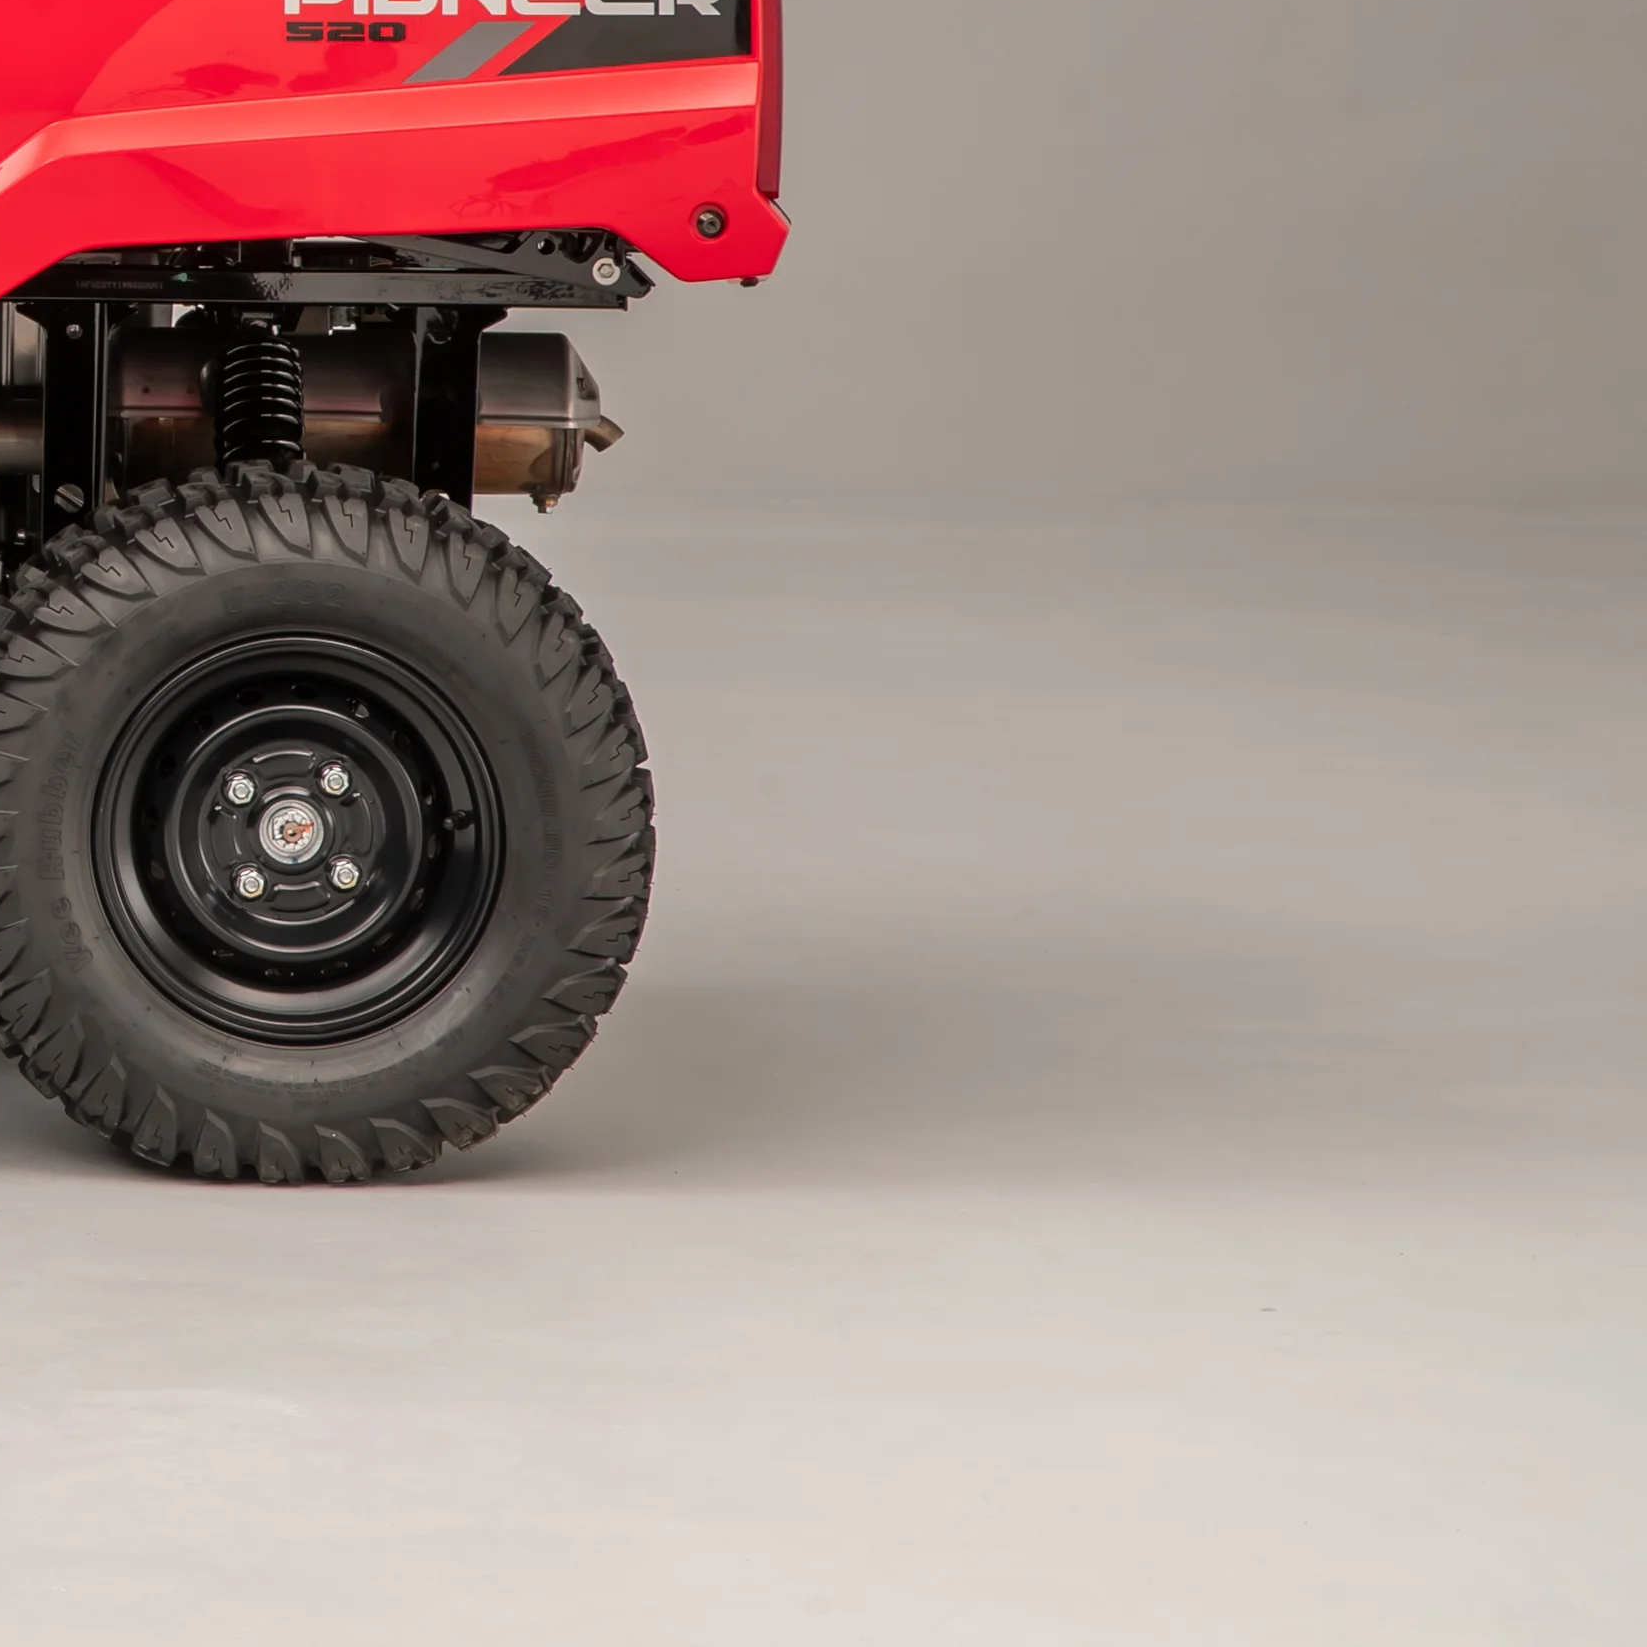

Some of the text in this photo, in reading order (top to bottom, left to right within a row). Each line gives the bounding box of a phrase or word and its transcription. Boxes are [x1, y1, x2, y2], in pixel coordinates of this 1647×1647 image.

[286, 22, 406, 43] 520
[37, 731, 94, 974] Vee Rubber
